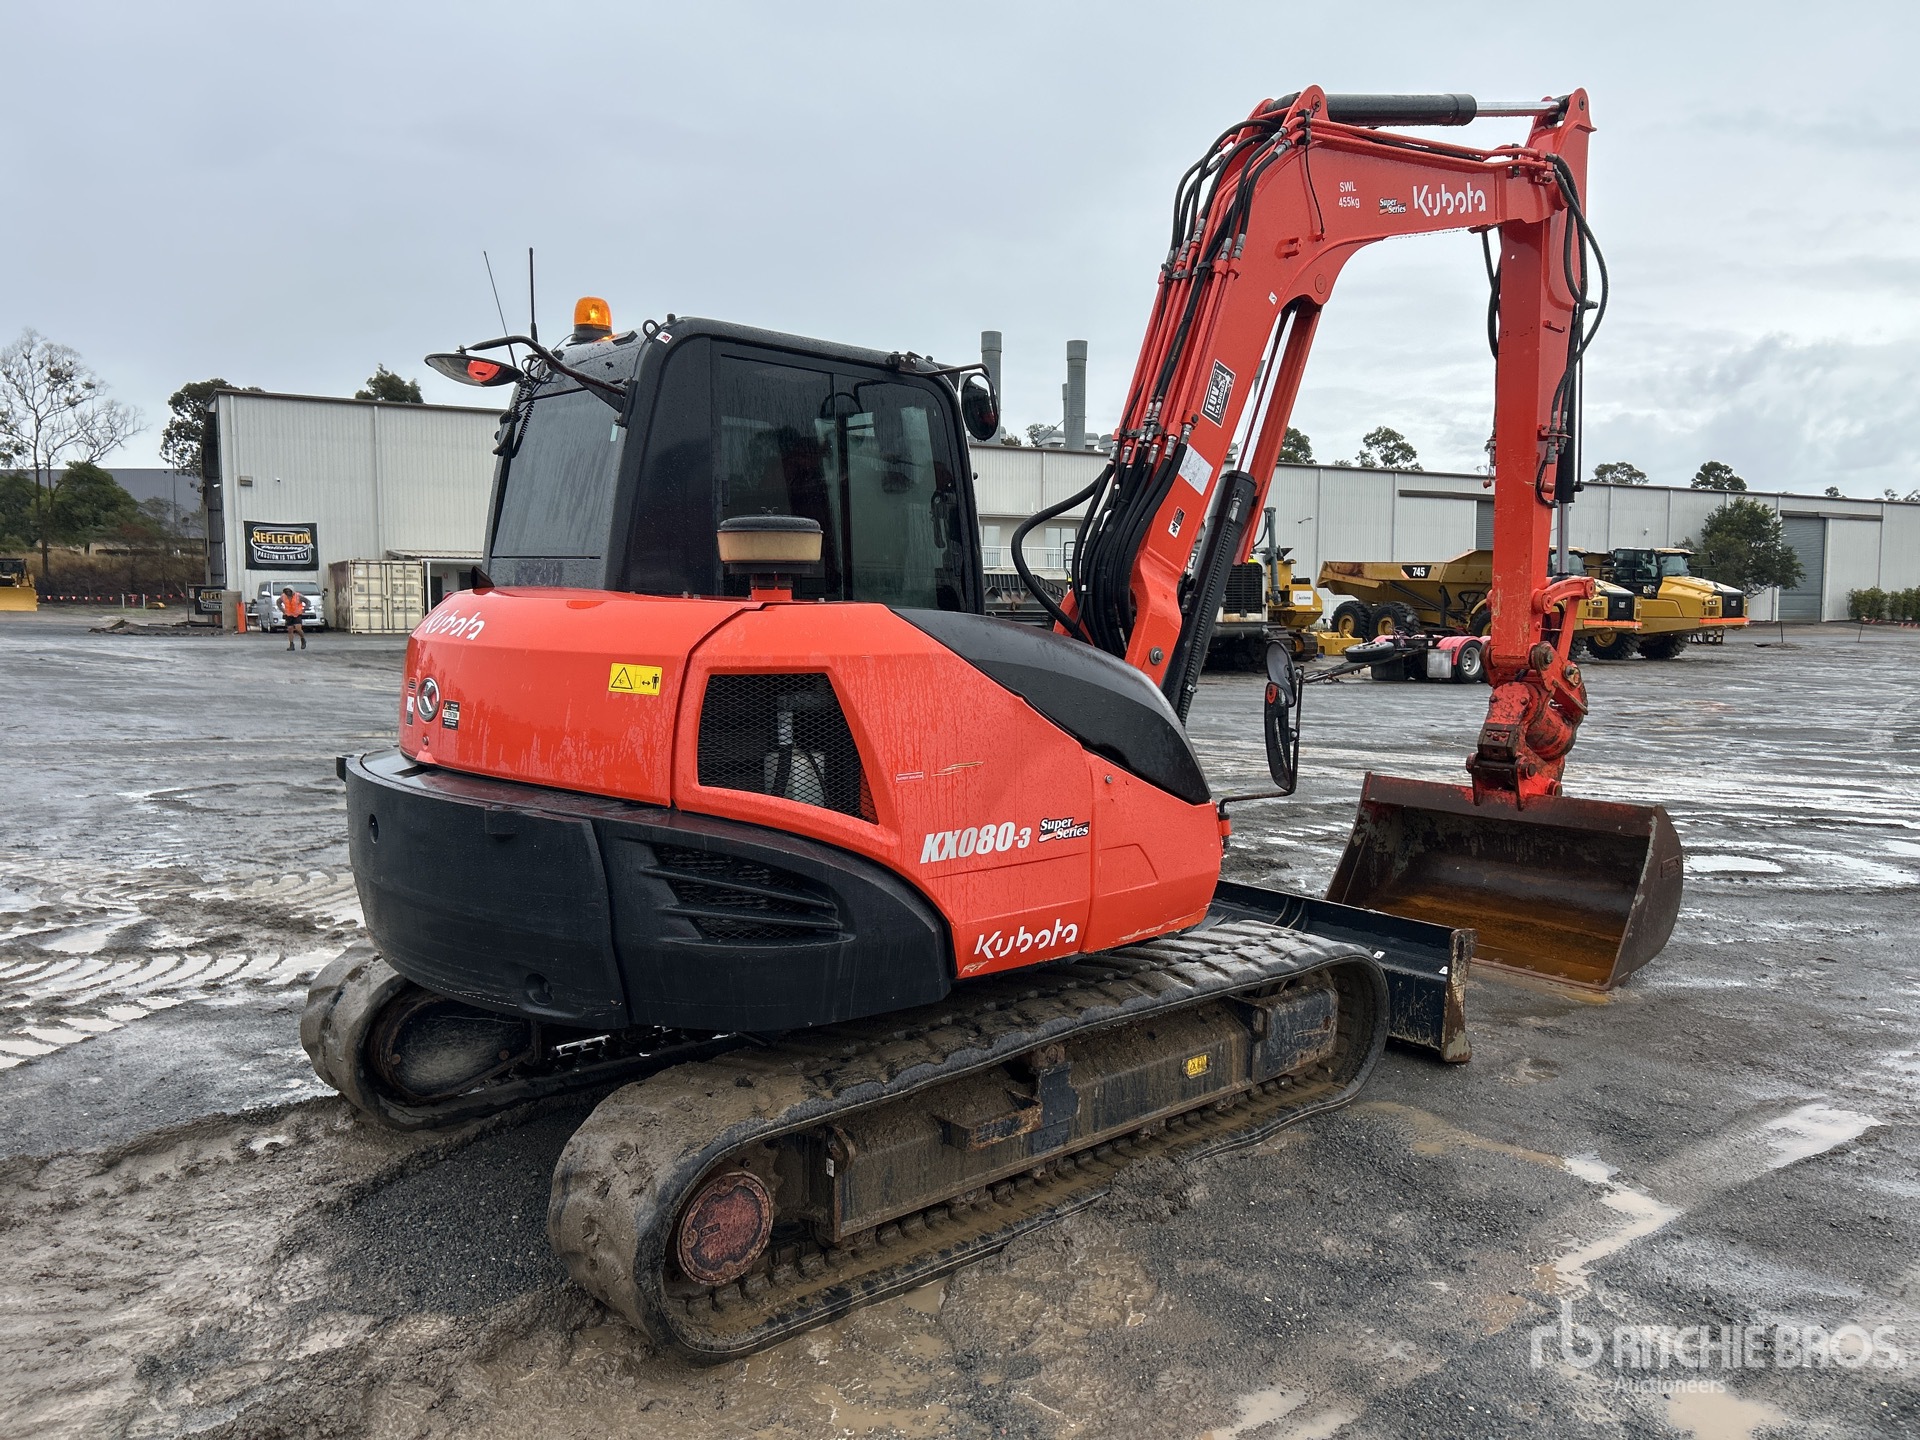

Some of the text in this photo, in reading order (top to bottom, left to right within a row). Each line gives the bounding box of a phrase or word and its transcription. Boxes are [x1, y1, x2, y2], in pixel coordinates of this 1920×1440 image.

[1339, 181, 1357, 193] SWL
[1338, 196, 1360, 208] 455kg
[1379, 198, 1397, 208] Super
[1413, 182, 1486, 218] Kubota
[1388, 205, 1406, 214] Series
[253, 531, 311, 544] REFLECTION
[257, 551, 279, 560] PASSION
[297, 551, 308, 560] KEY
[1412, 567, 1425, 577] 745
[425, 608, 486, 641] Kubota
[1040, 818, 1074, 832] Super
[1056, 825, 1089, 839] Series
[919, 821, 1032, 864] KX080-3
[973, 918, 1079, 960] Kubota
